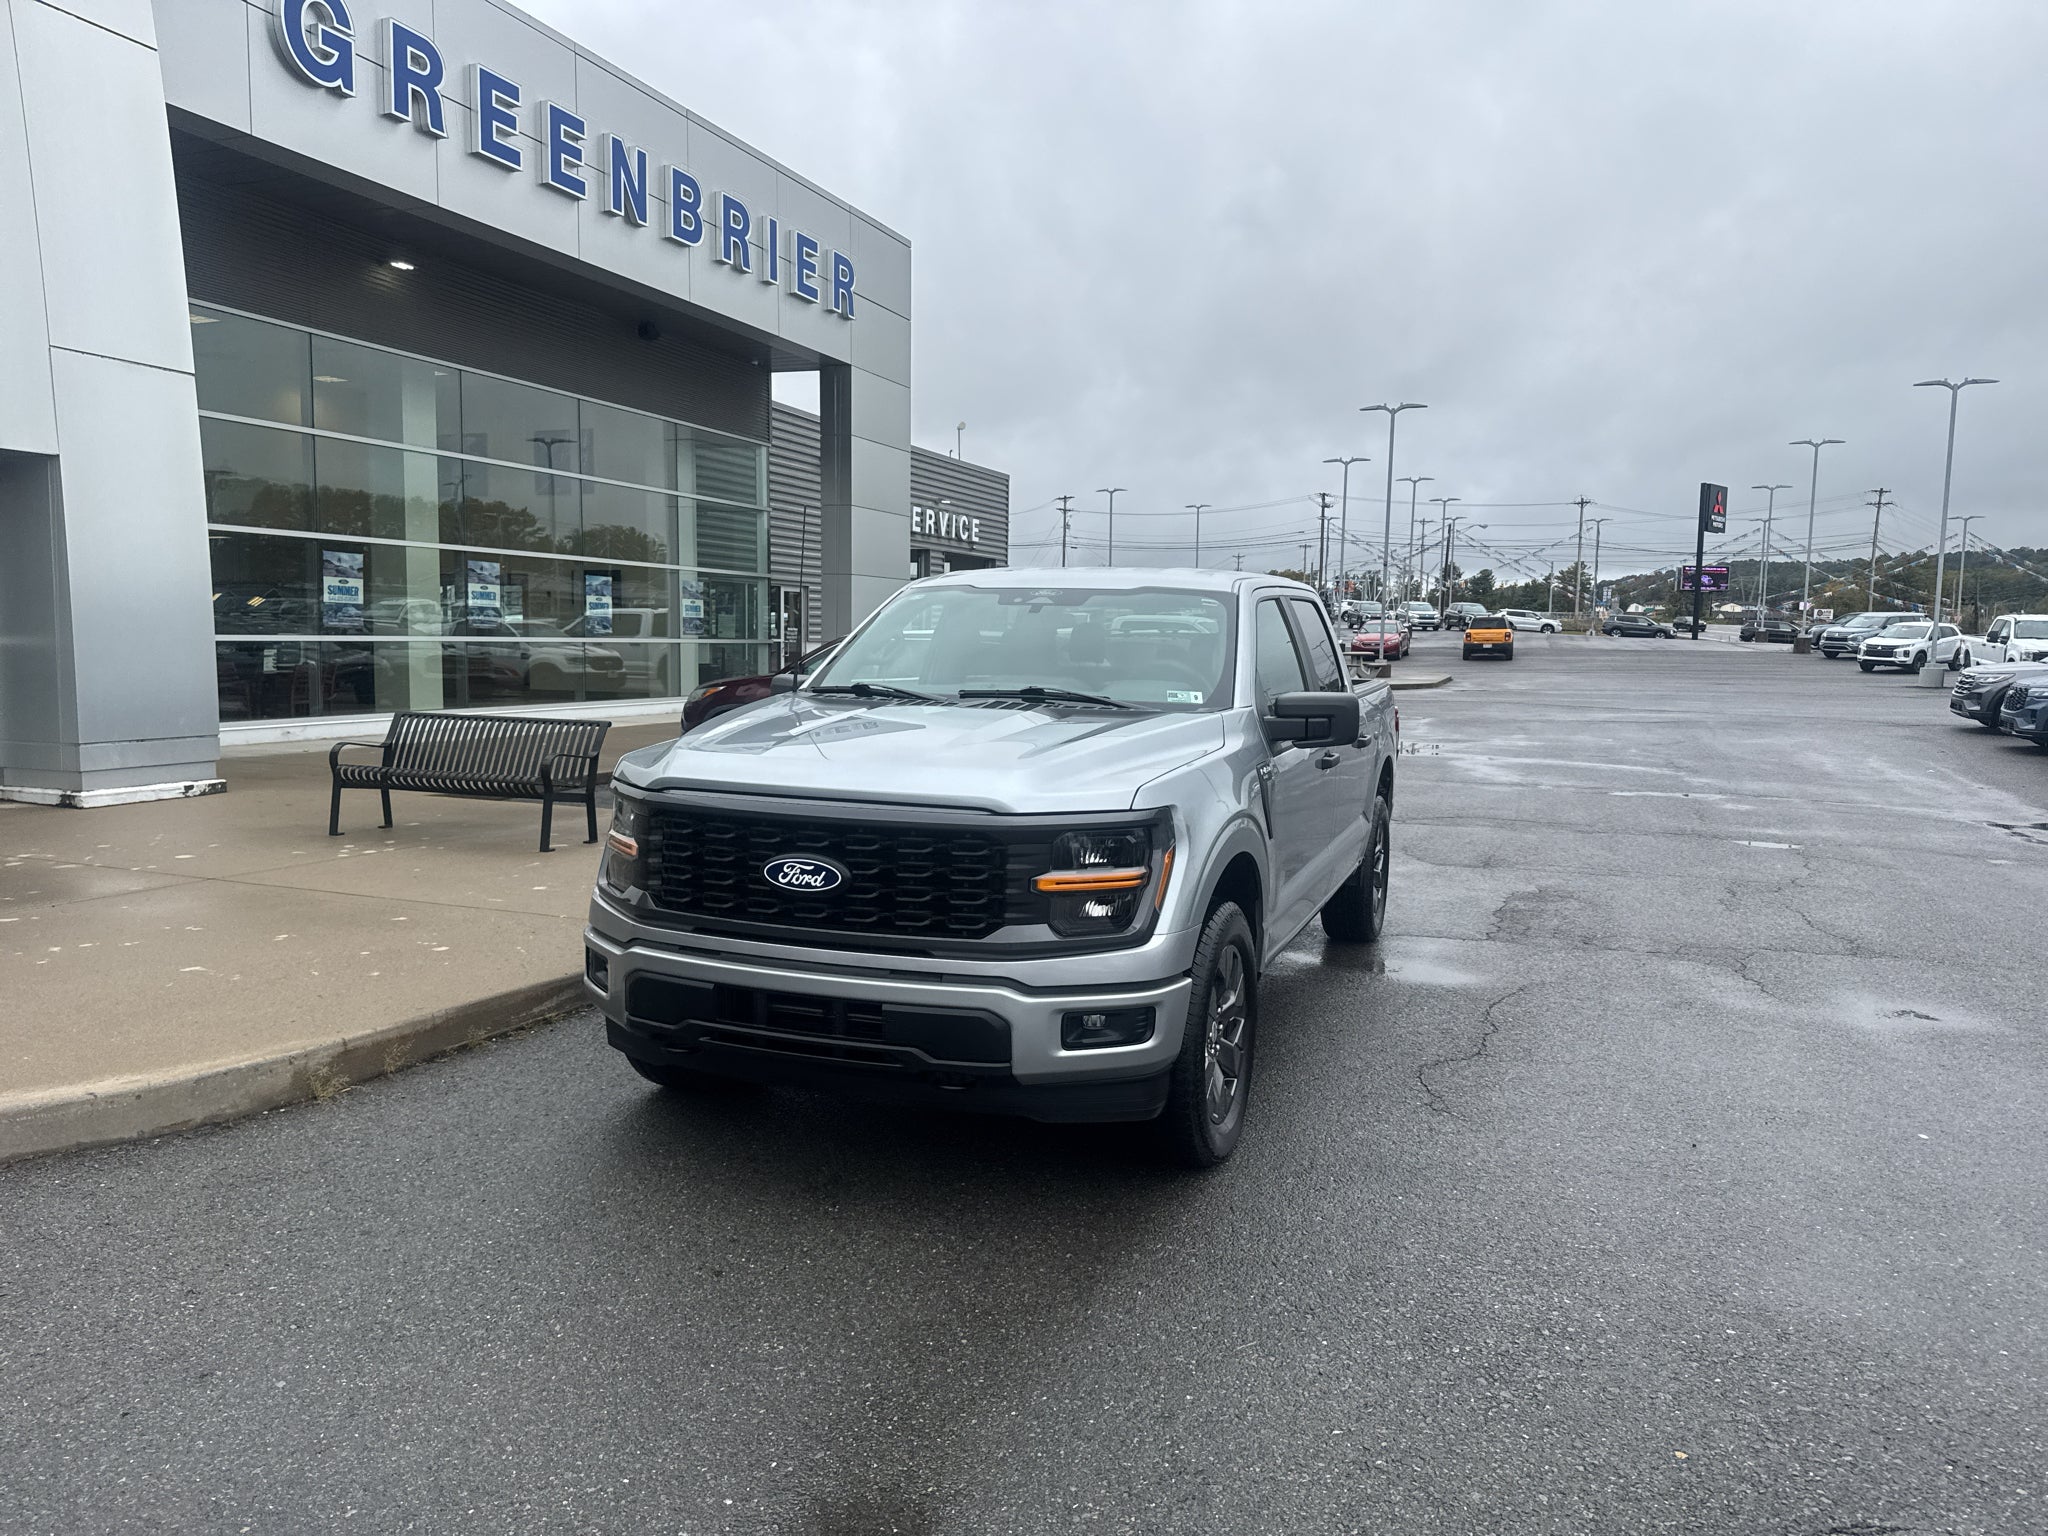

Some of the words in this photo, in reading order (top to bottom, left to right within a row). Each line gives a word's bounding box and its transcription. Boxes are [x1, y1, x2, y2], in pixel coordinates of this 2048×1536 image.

[272, 0, 857, 320] GREENBRIER
[911, 506, 980, 542] ERVICE
[327, 585, 359, 597] SUMMER
[778, 862, 826, 886] Ford
